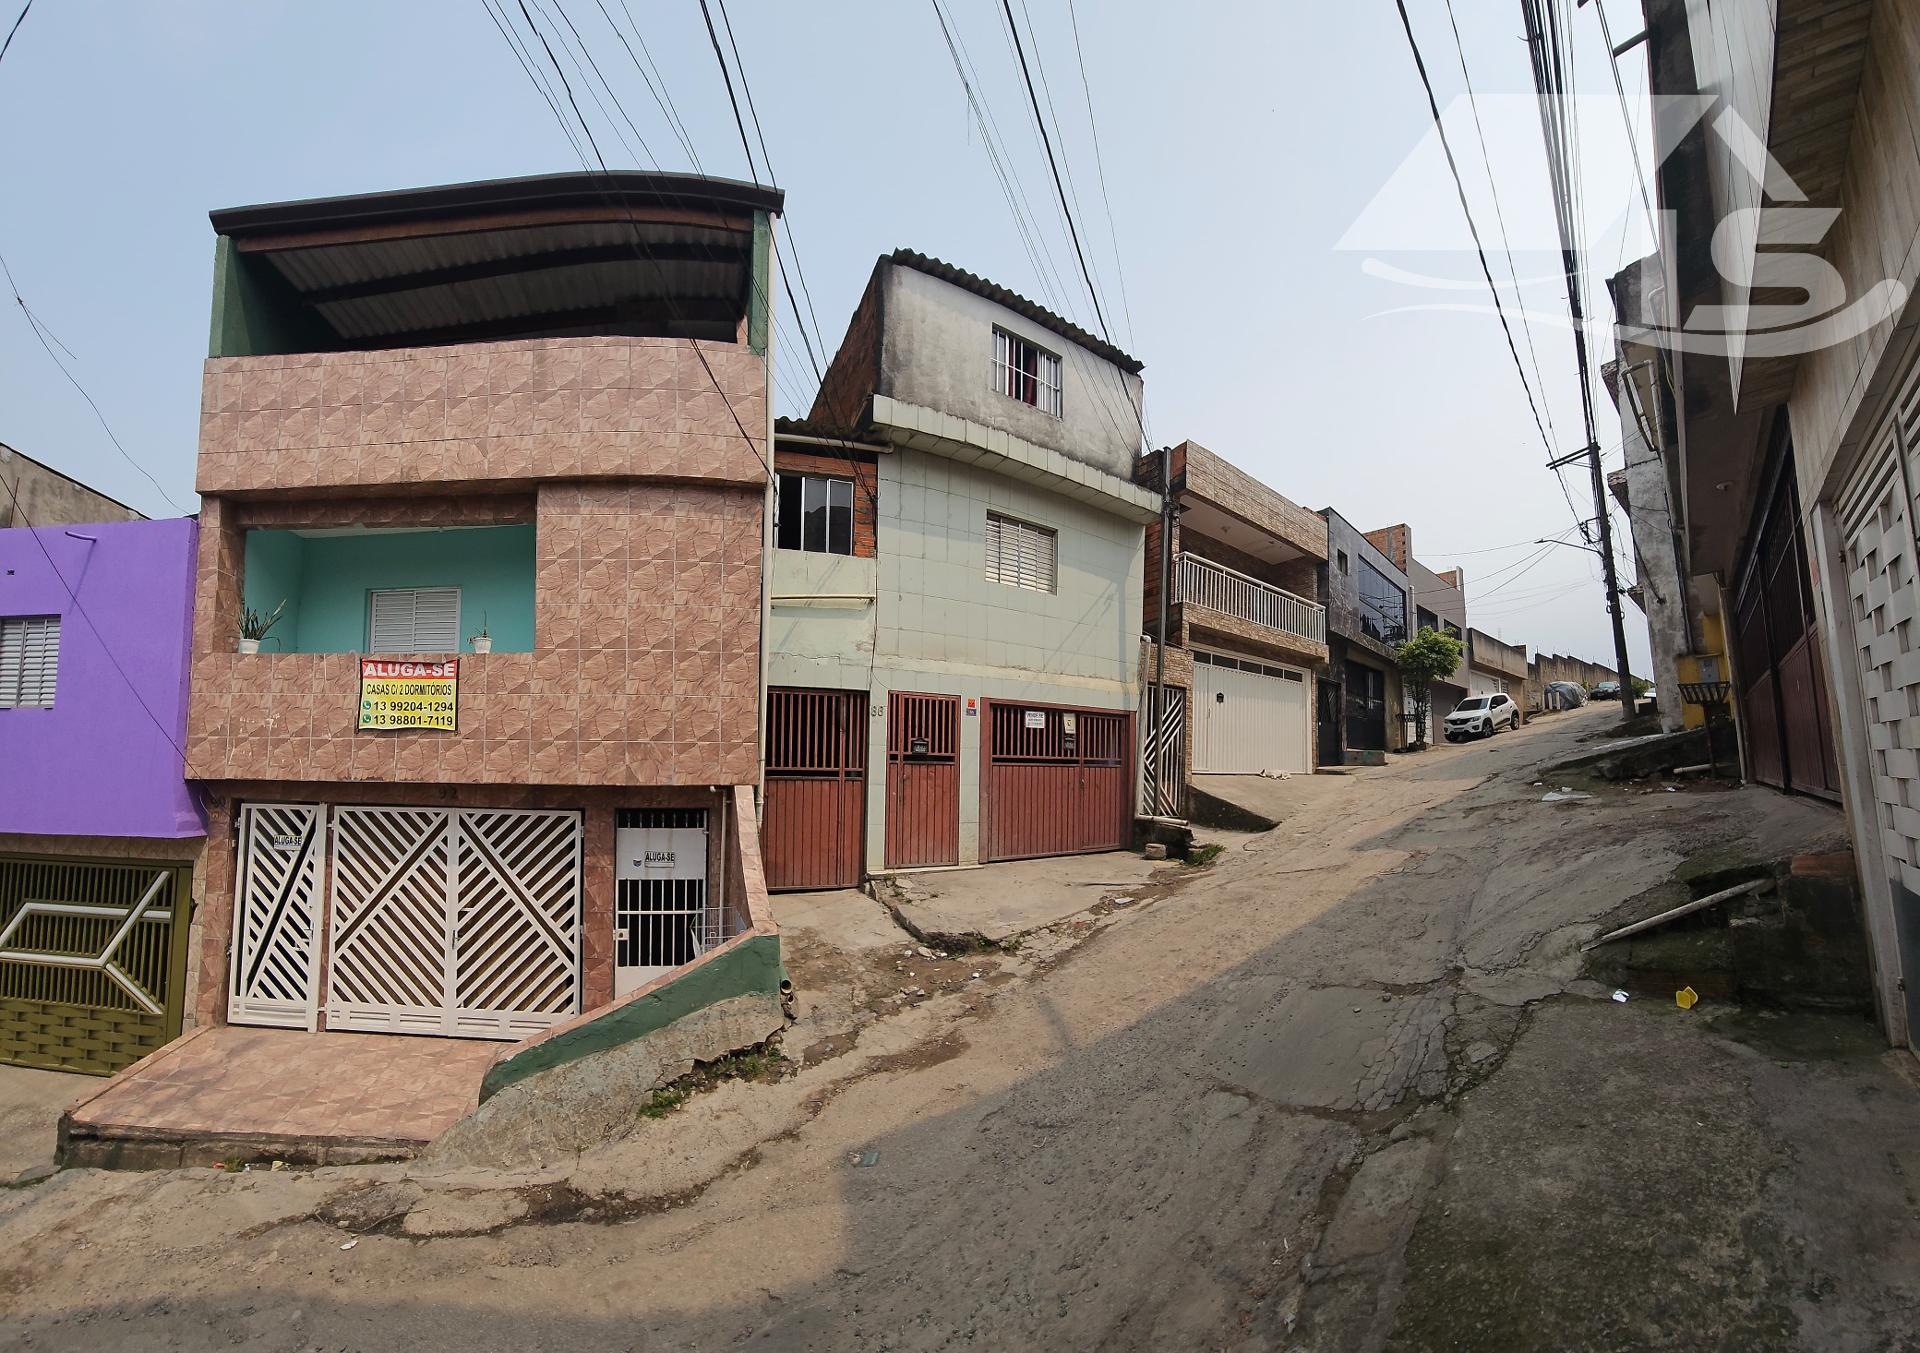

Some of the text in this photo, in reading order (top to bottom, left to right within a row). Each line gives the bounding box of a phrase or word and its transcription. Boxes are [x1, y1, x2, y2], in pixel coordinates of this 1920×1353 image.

[364, 663, 455, 677] ALUGA-SE
[366, 684, 390, 695] CASAS
[399, 685, 404, 695] 2
[404, 682, 452, 695] DORMITÓRIOS
[373, 701, 454, 712] 13 99204-1294
[373, 715, 453, 726] 13 98801-7119
[274, 836, 301, 846] ALUGA-SE
[645, 852, 675, 861] ALUGA-SE
